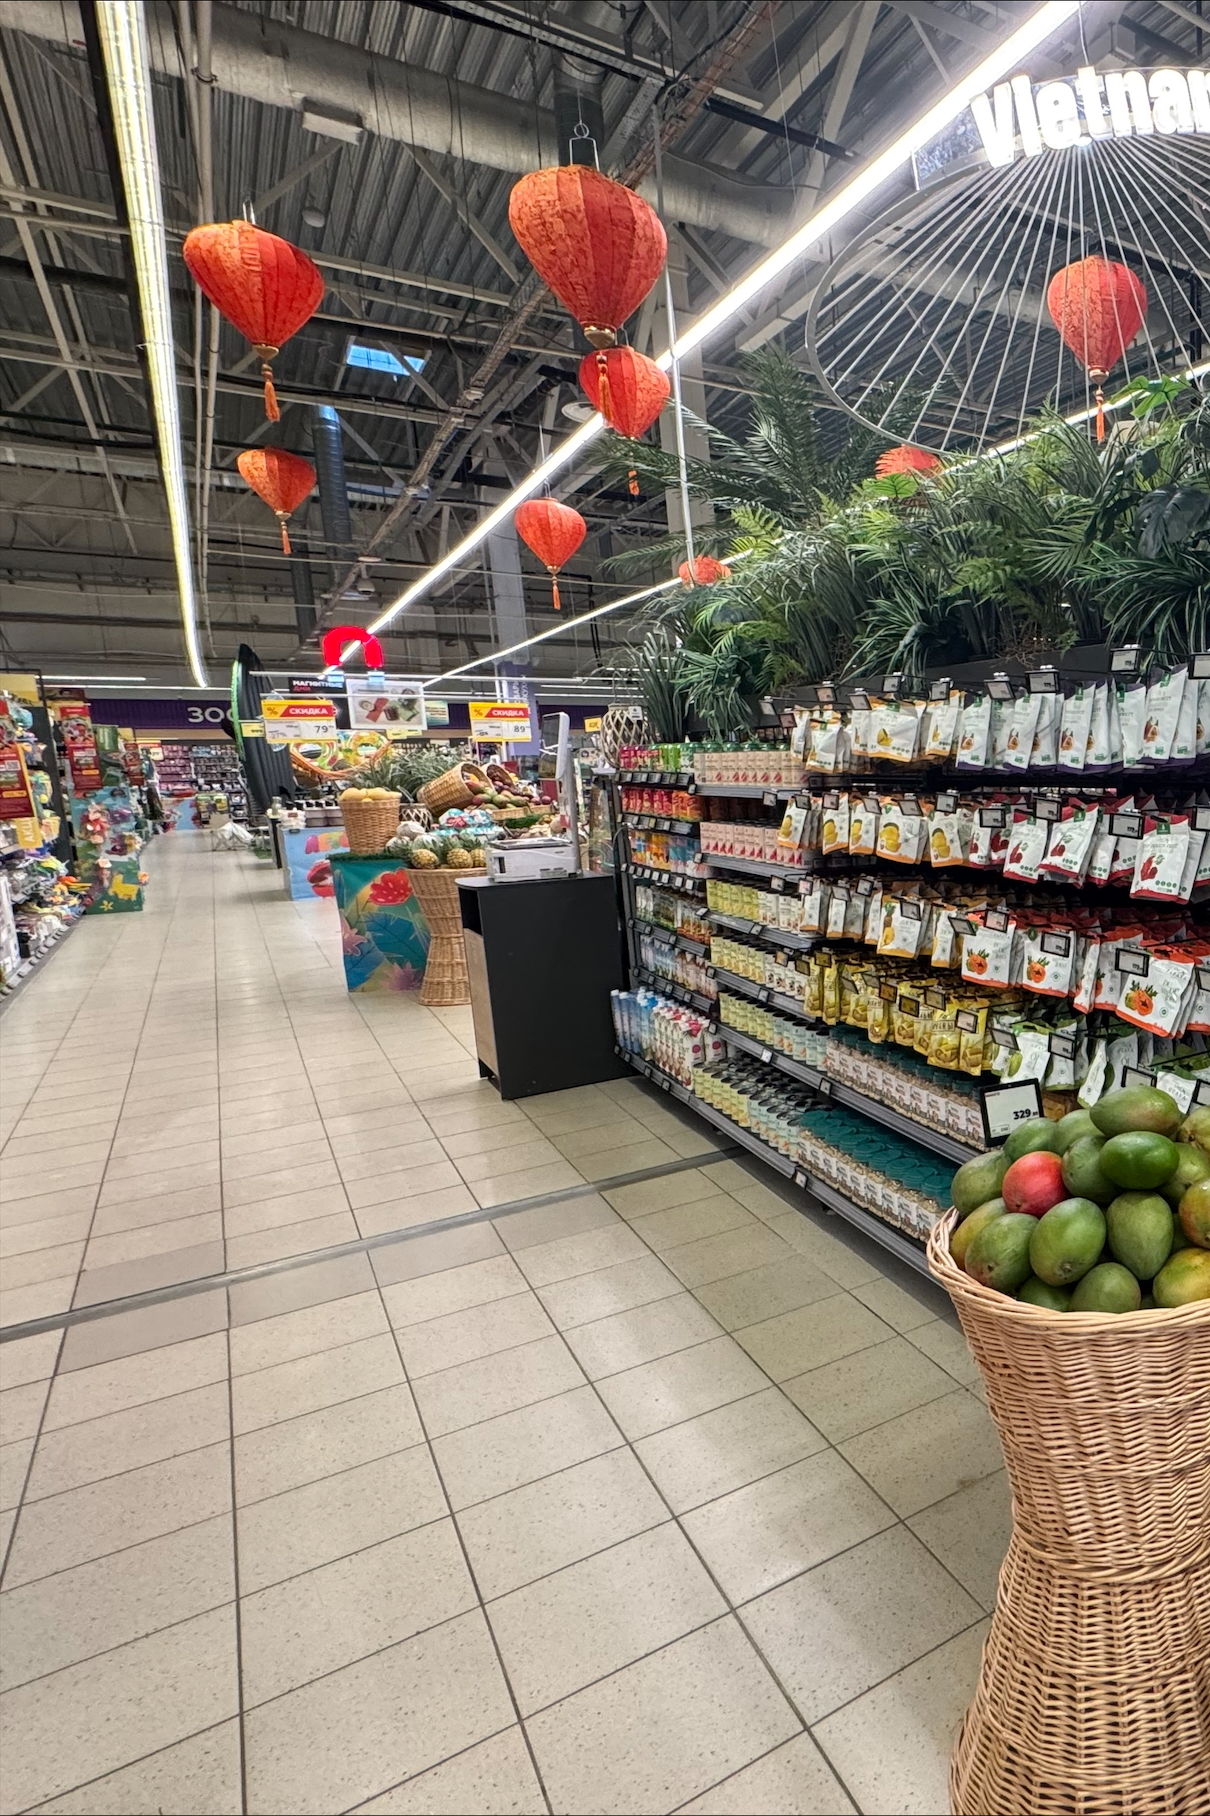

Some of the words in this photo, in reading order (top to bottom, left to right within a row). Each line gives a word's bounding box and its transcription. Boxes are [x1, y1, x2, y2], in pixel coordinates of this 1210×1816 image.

[289, 707, 328, 716] СКИДКА
[314, 725, 329, 734] 79
[513, 725, 525, 733] 89
[1013, 1108, 1031, 1120] 329
